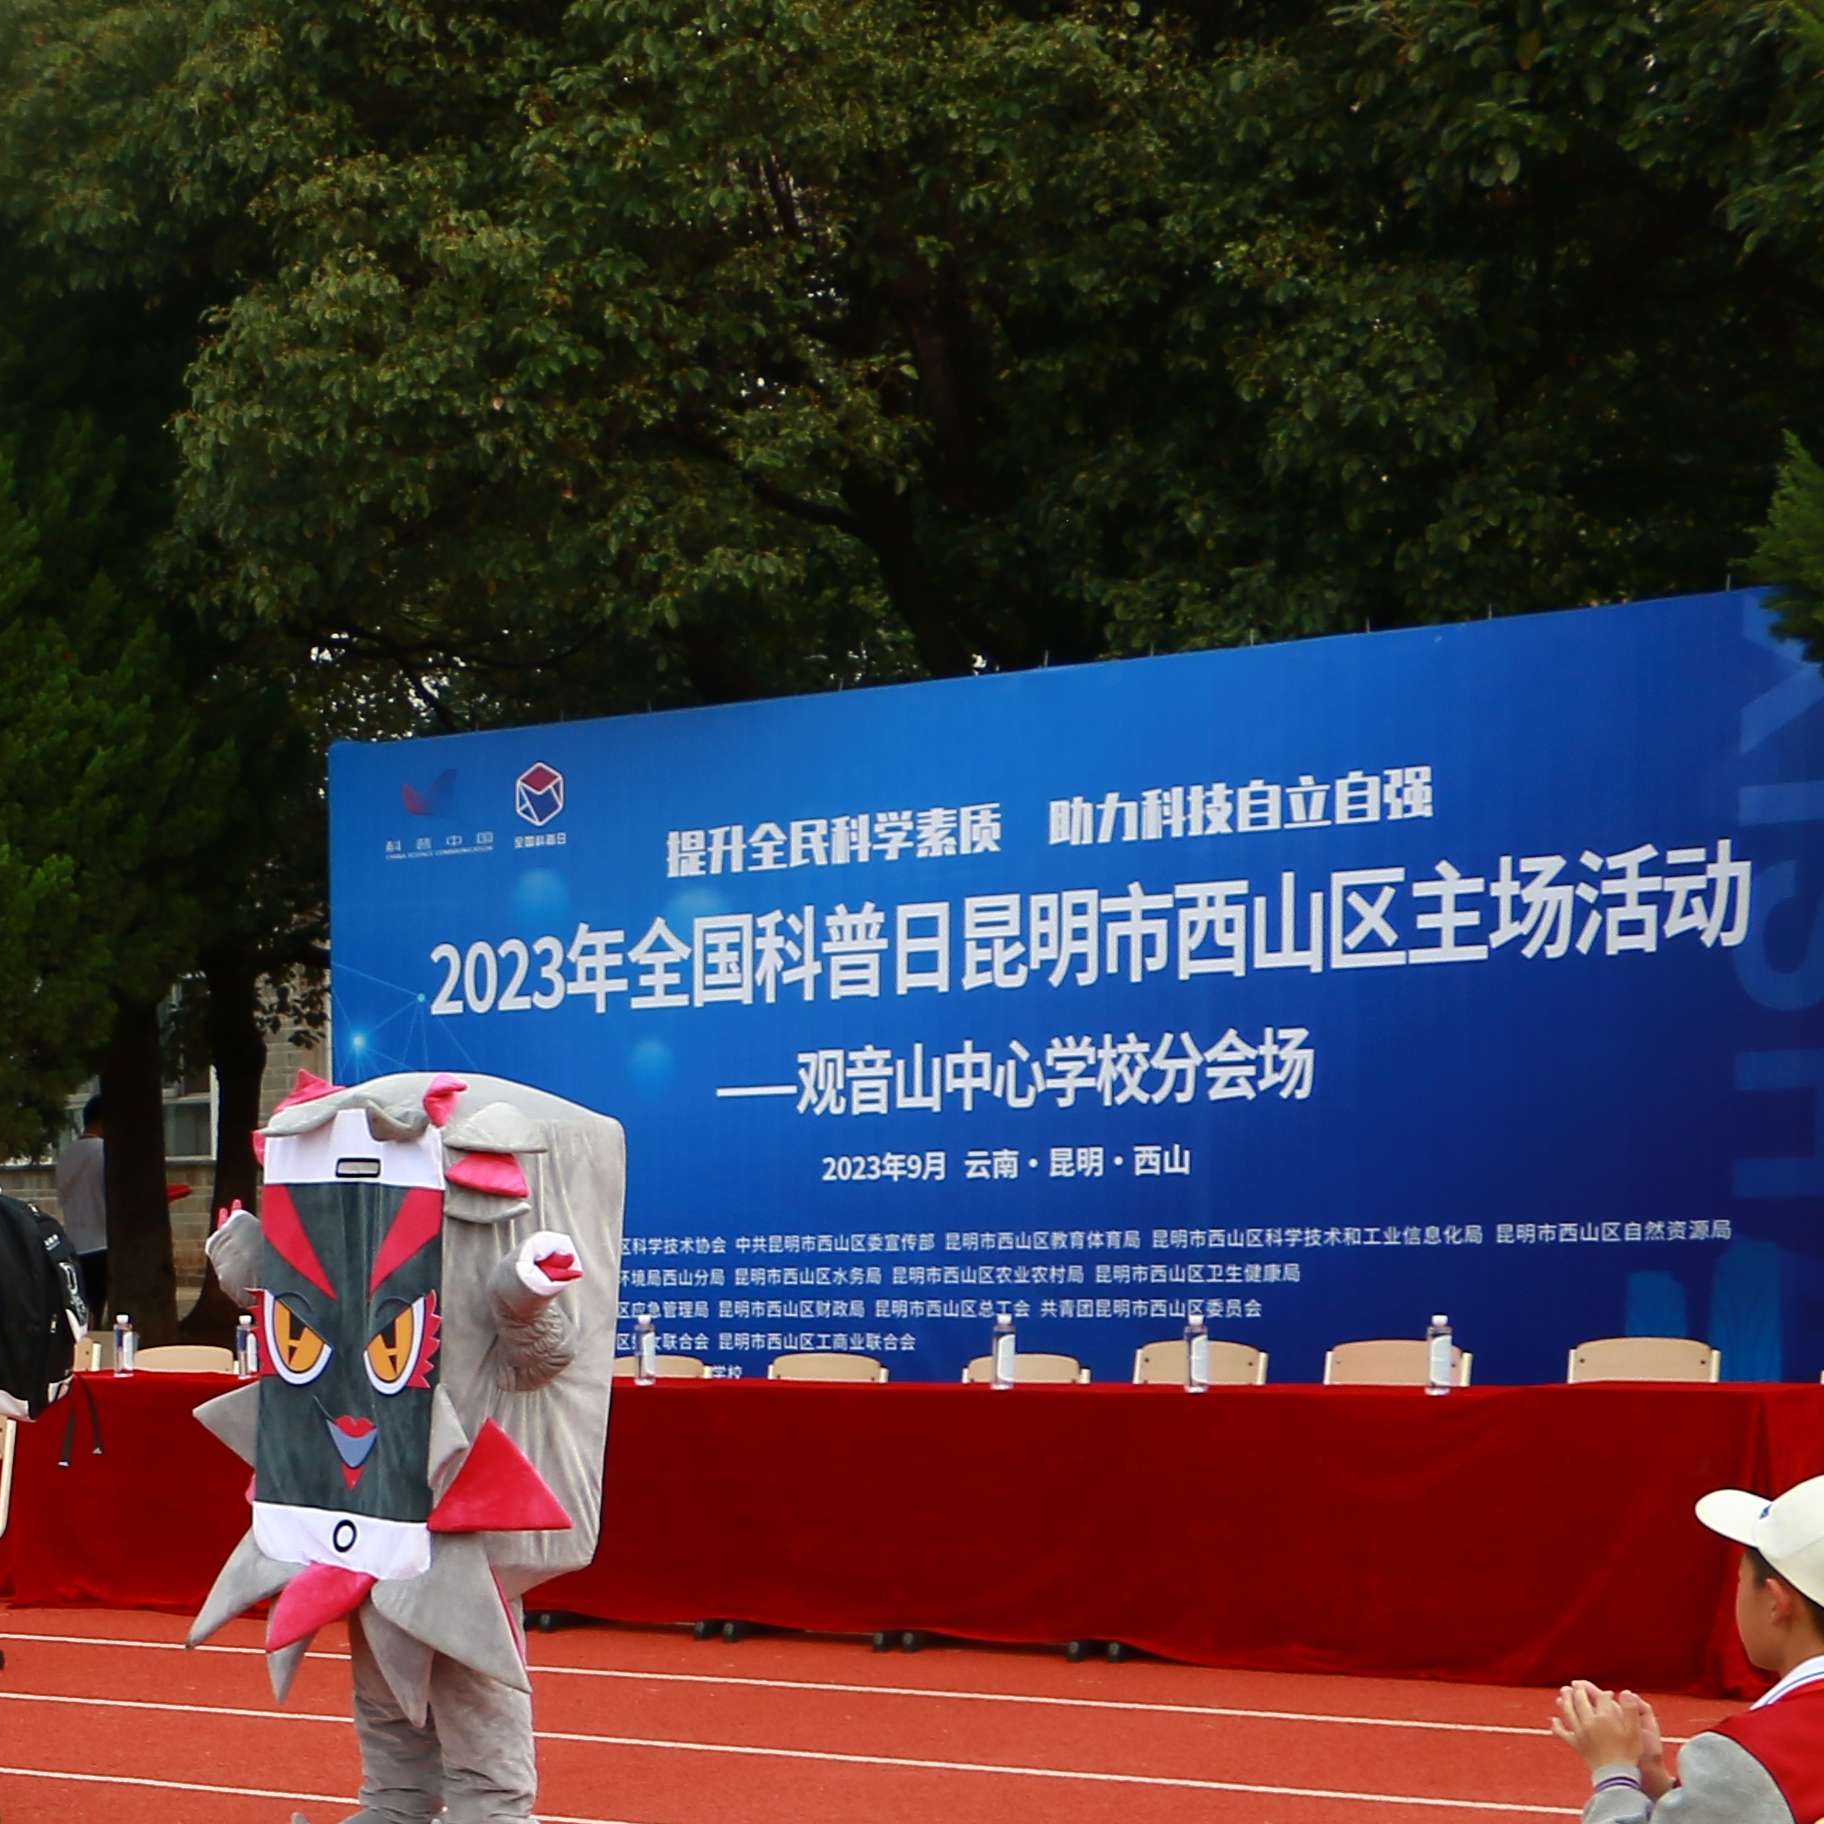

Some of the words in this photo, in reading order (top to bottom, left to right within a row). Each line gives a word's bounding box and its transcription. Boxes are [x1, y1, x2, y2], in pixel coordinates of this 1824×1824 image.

[666, 803, 1001, 878] 提升全民科学素质
[1049, 766, 1433, 846] 助力科技自立自强
[430, 839, 1751, 1015] 2023年全国科普日昆明市西山区主场活动
[822, 1151, 945, 1182] 2023年9月
[735, 1233, 935, 1253] 中共昆明市西山区委宣传部
[945, 1230, 1140, 1251] 昆明市西山区教育体育局
[1152, 1226, 1483, 1249] 昆明市西山区科学技术和工业信息化局
[1496, 1219, 1731, 1244] 昆明市西山区自然资源局
[735, 1266, 882, 1286] 昆明市西山区水务局
[892, 1265, 1084, 1285] 昆明市西山区农业农村局
[1096, 1263, 1300, 1284] 昆明市西山区卫生健康局
[719, 1299, 865, 1318] 昆明市西山区财政局
[875, 1299, 1030, 1319] 昆明市西山区总工会
[1040, 1298, 1262, 1319] 共青团昆明市西山区委员会
[719, 1332, 916, 1351] 昆明市西山区工商业联合会
